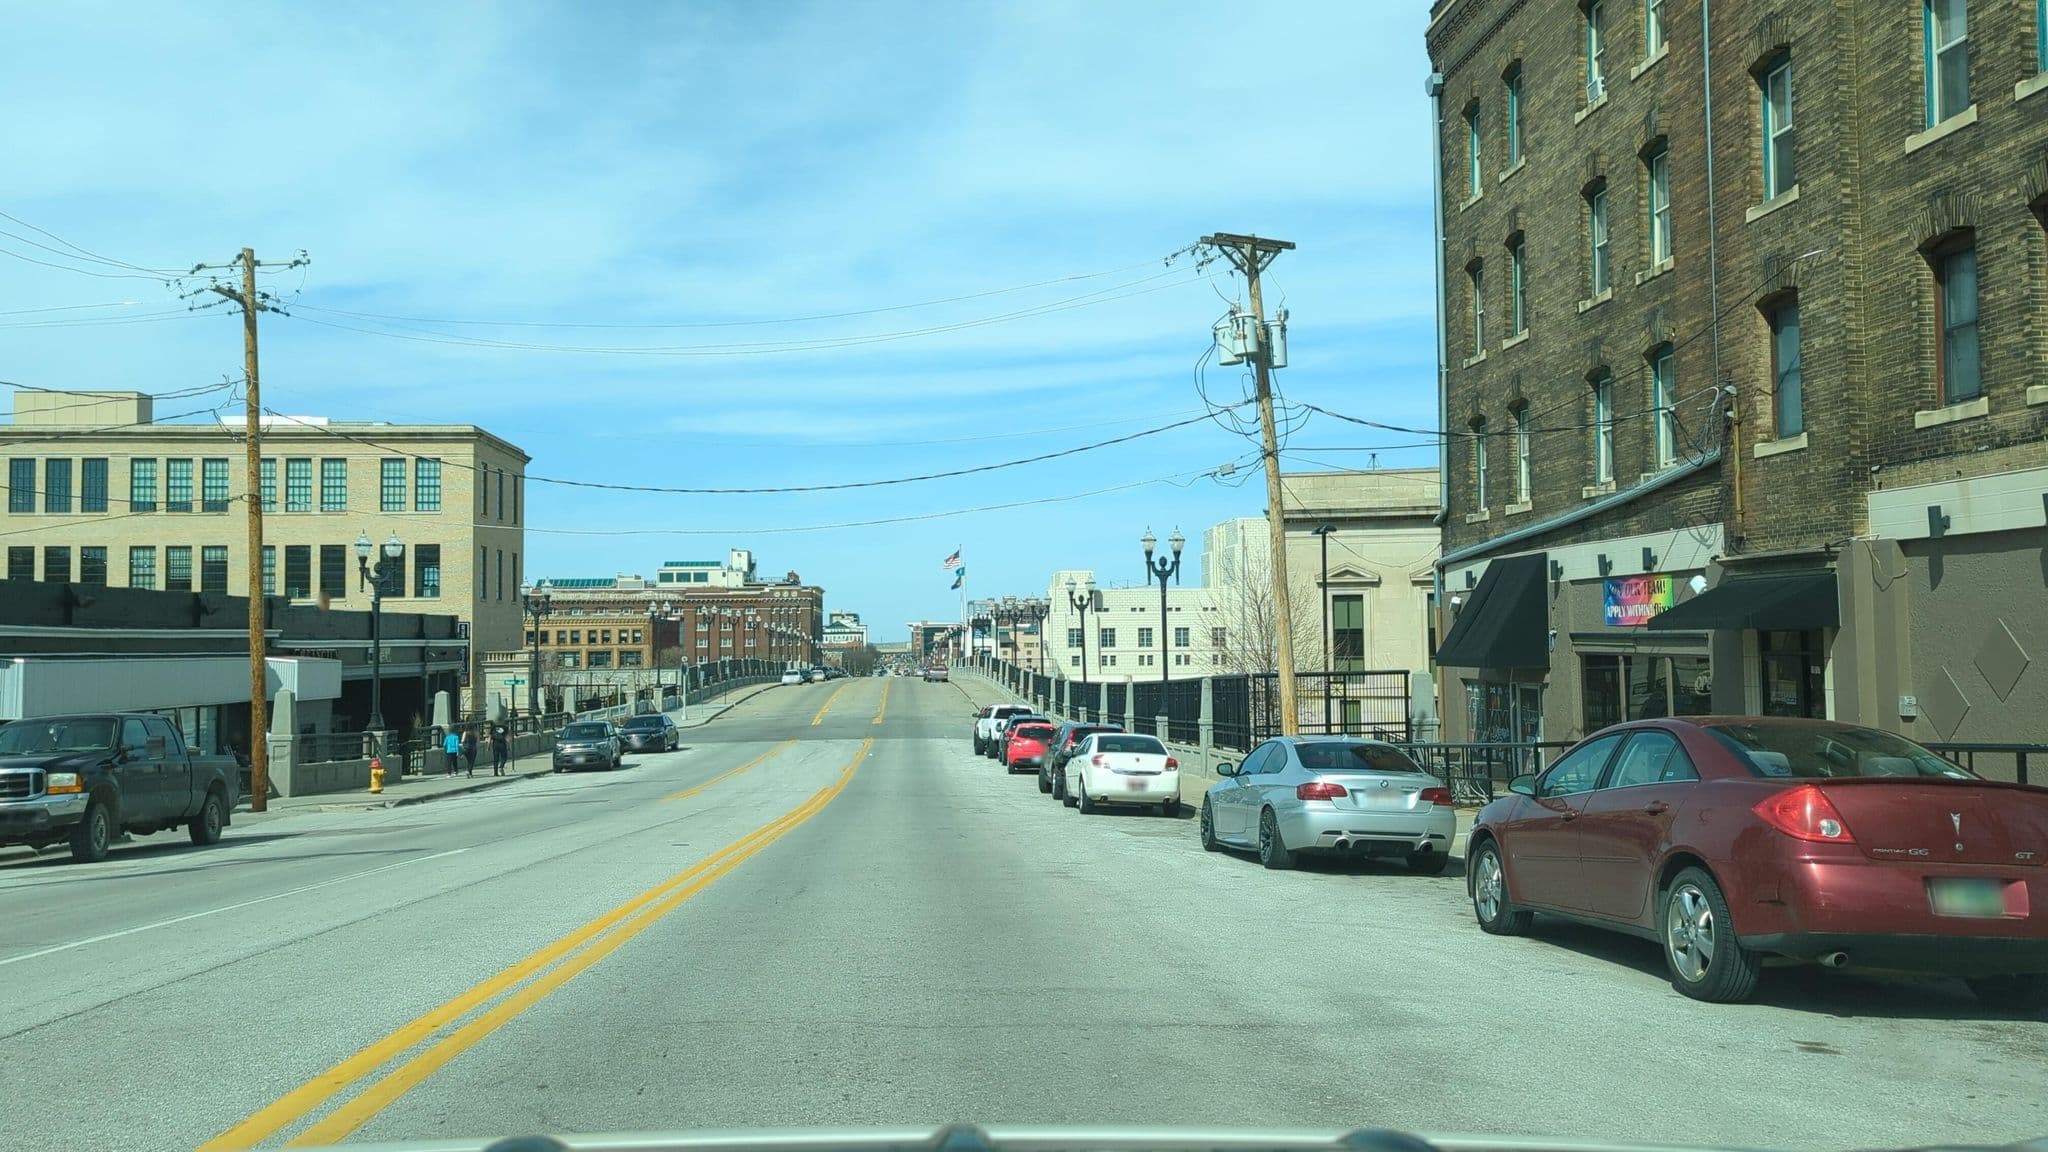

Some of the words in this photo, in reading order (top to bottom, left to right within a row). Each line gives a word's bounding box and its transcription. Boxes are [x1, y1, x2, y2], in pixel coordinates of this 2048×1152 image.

[1625, 583, 1641, 597] OUR
[1643, 580, 1666, 595] TEAM!
[1607, 604, 1626, 618] APPLY
[2015, 851, 2035, 860] GT
